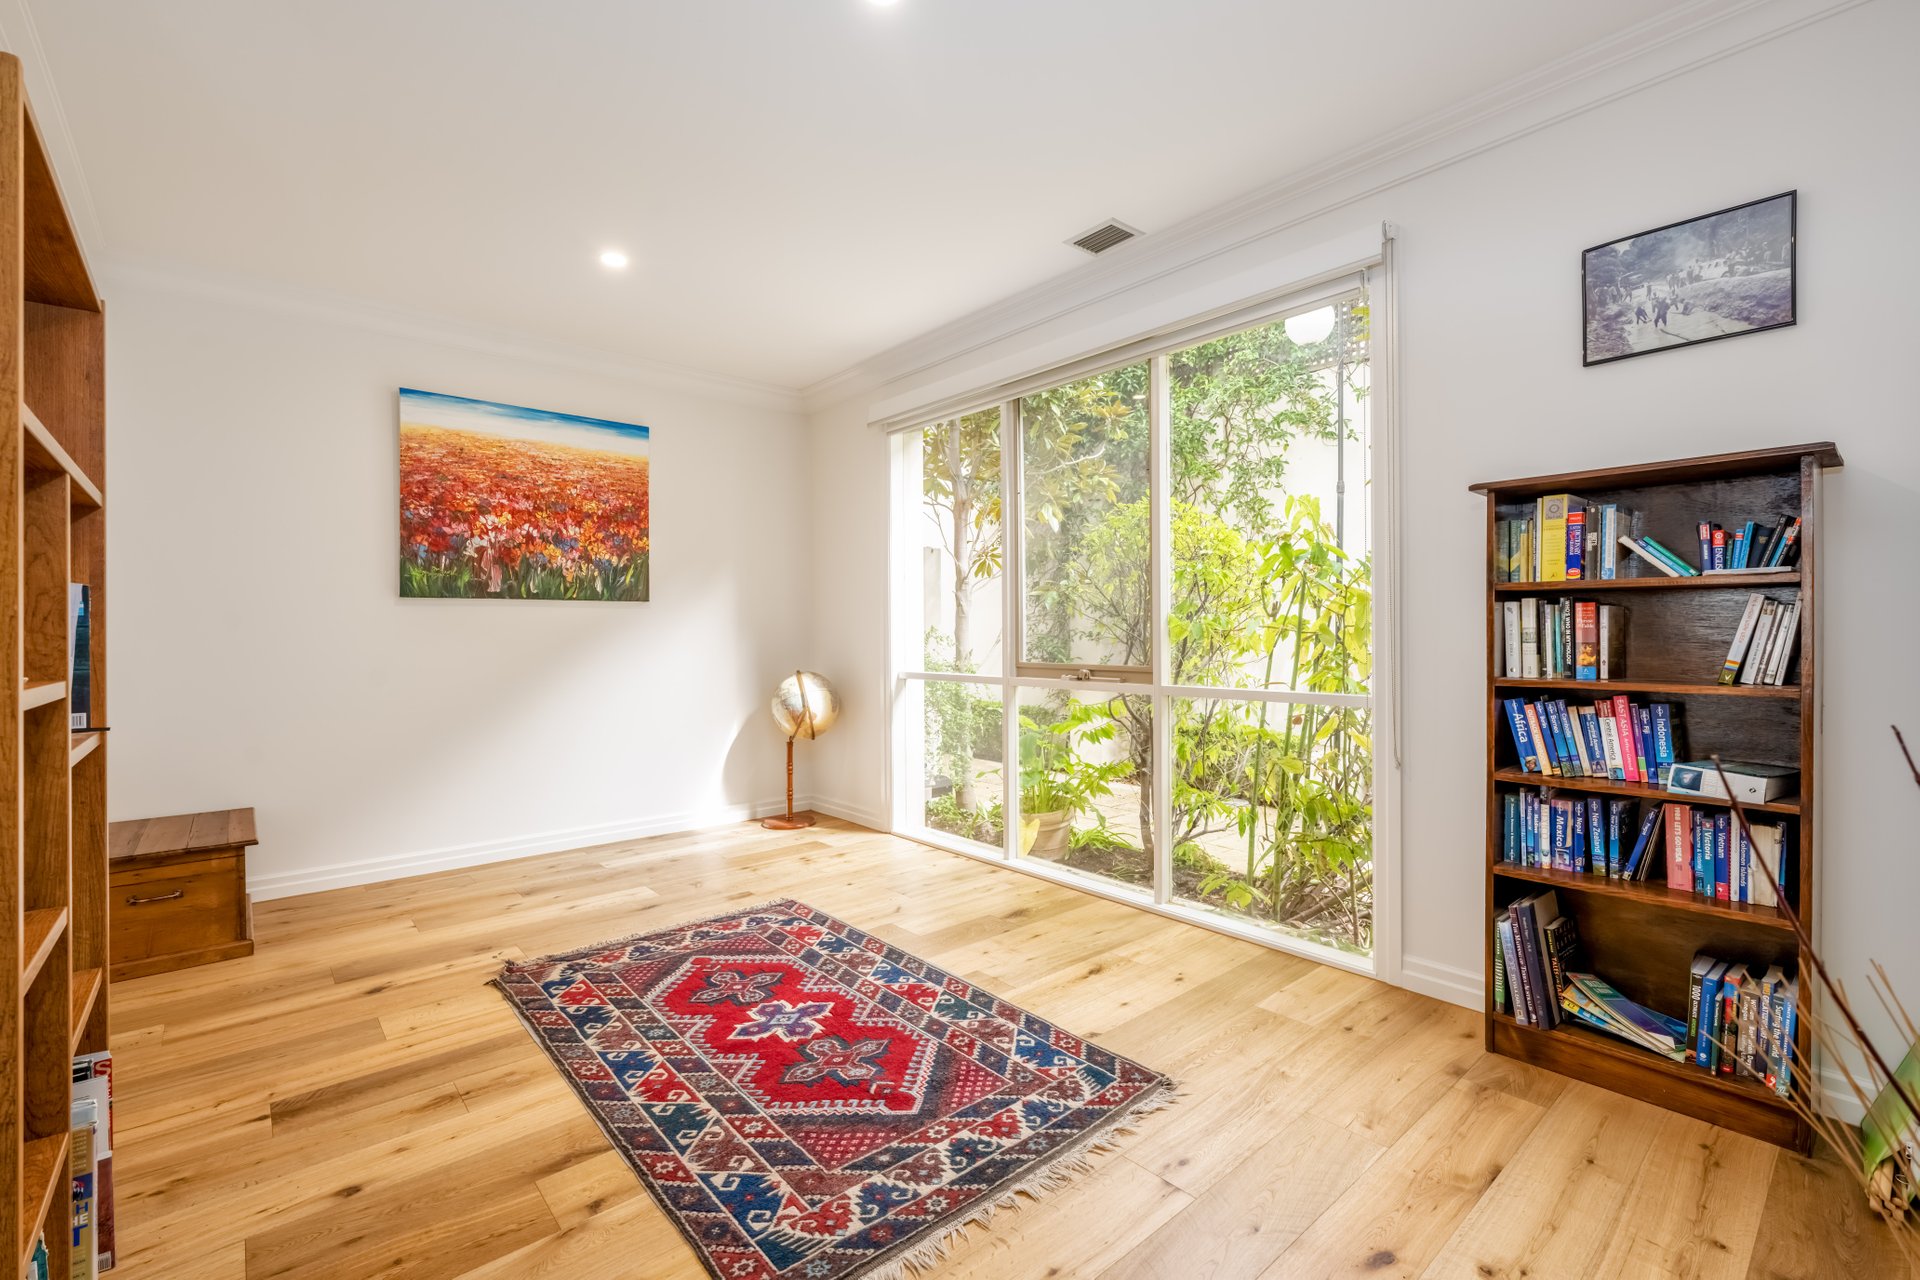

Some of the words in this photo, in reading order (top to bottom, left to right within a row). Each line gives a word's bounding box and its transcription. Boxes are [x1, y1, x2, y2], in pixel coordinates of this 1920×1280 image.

[1617, 699, 1626, 717] EAST
[1513, 714, 1528, 742] Africa
[1562, 713, 1572, 737] Cambodia
[1620, 719, 1629, 736] ASIA
[1608, 738, 1616, 760] America
[1657, 719, 1668, 758] Indonesia
[1593, 828, 1601, 853] Zealand
[1692, 985, 1701, 1000] 1000
[1773, 1005, 1783, 1028] Surfg
